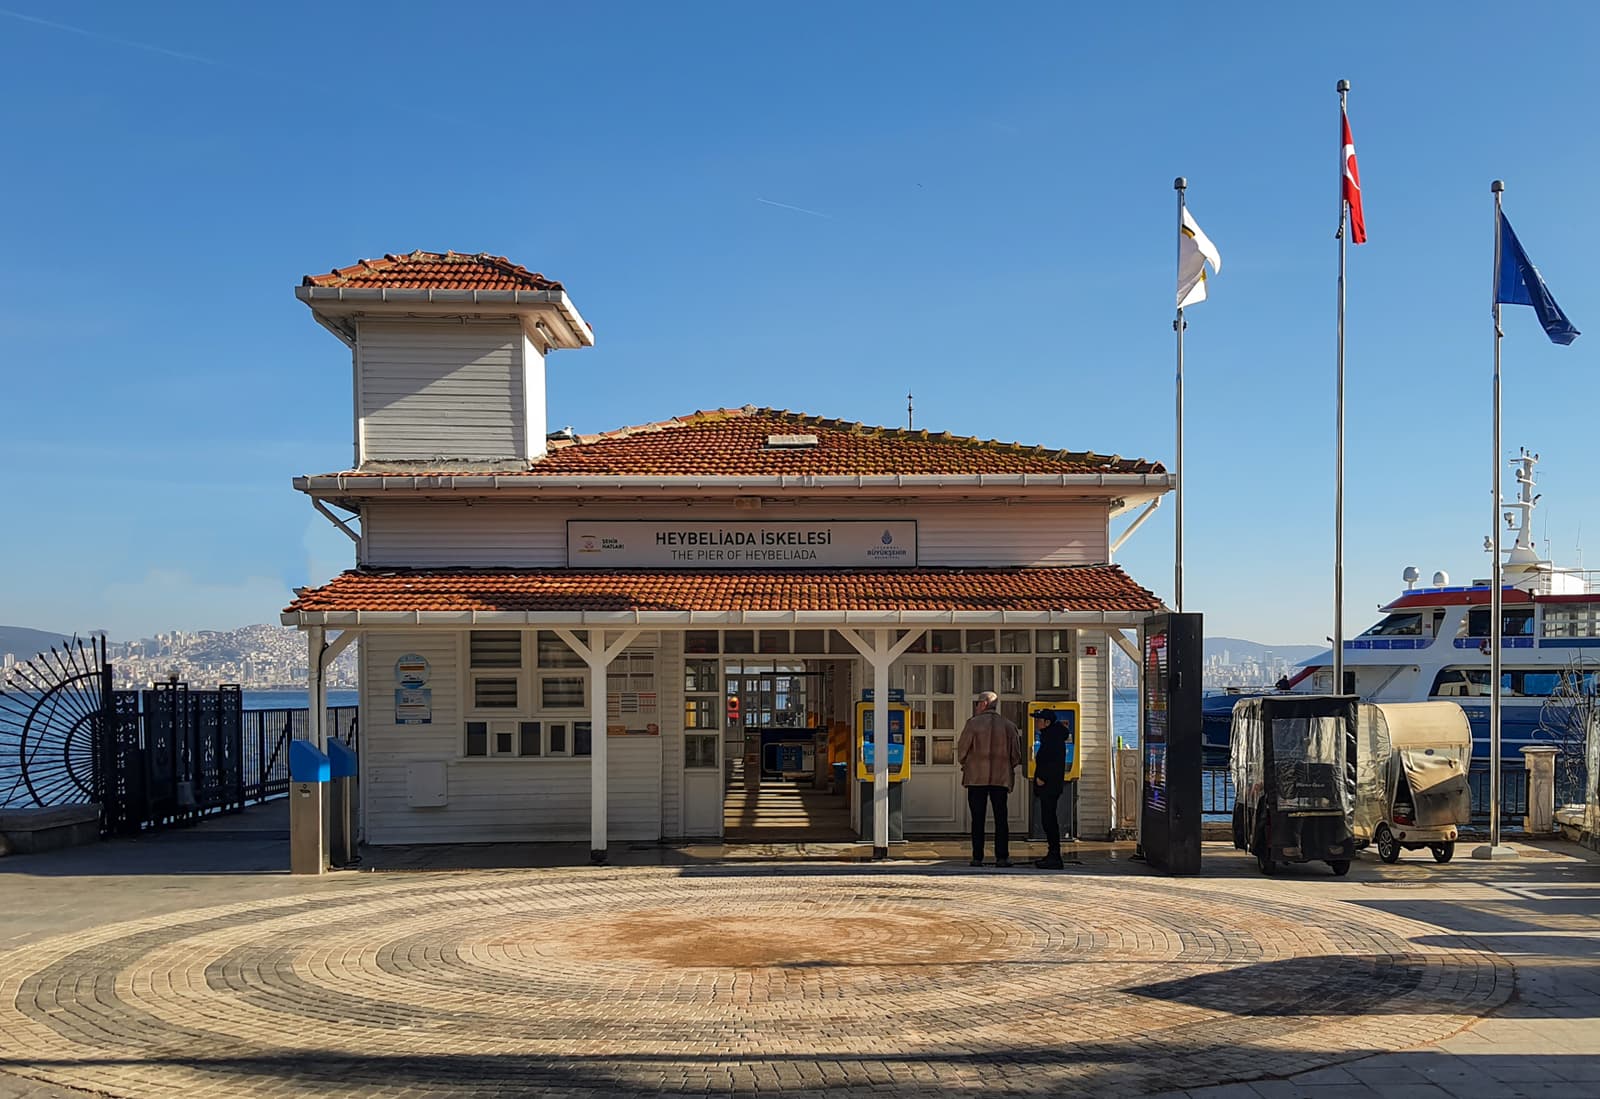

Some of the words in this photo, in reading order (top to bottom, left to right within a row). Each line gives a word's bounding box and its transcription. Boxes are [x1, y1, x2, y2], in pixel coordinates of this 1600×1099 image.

[655, 529, 757, 545] HEYBELİADA
[761, 529, 832, 545] İSKELESİ
[671, 550, 694, 561] THE
[697, 550, 724, 561] PIER
[727, 550, 742, 561] OF
[745, 549, 817, 561] HEYBELIADA
